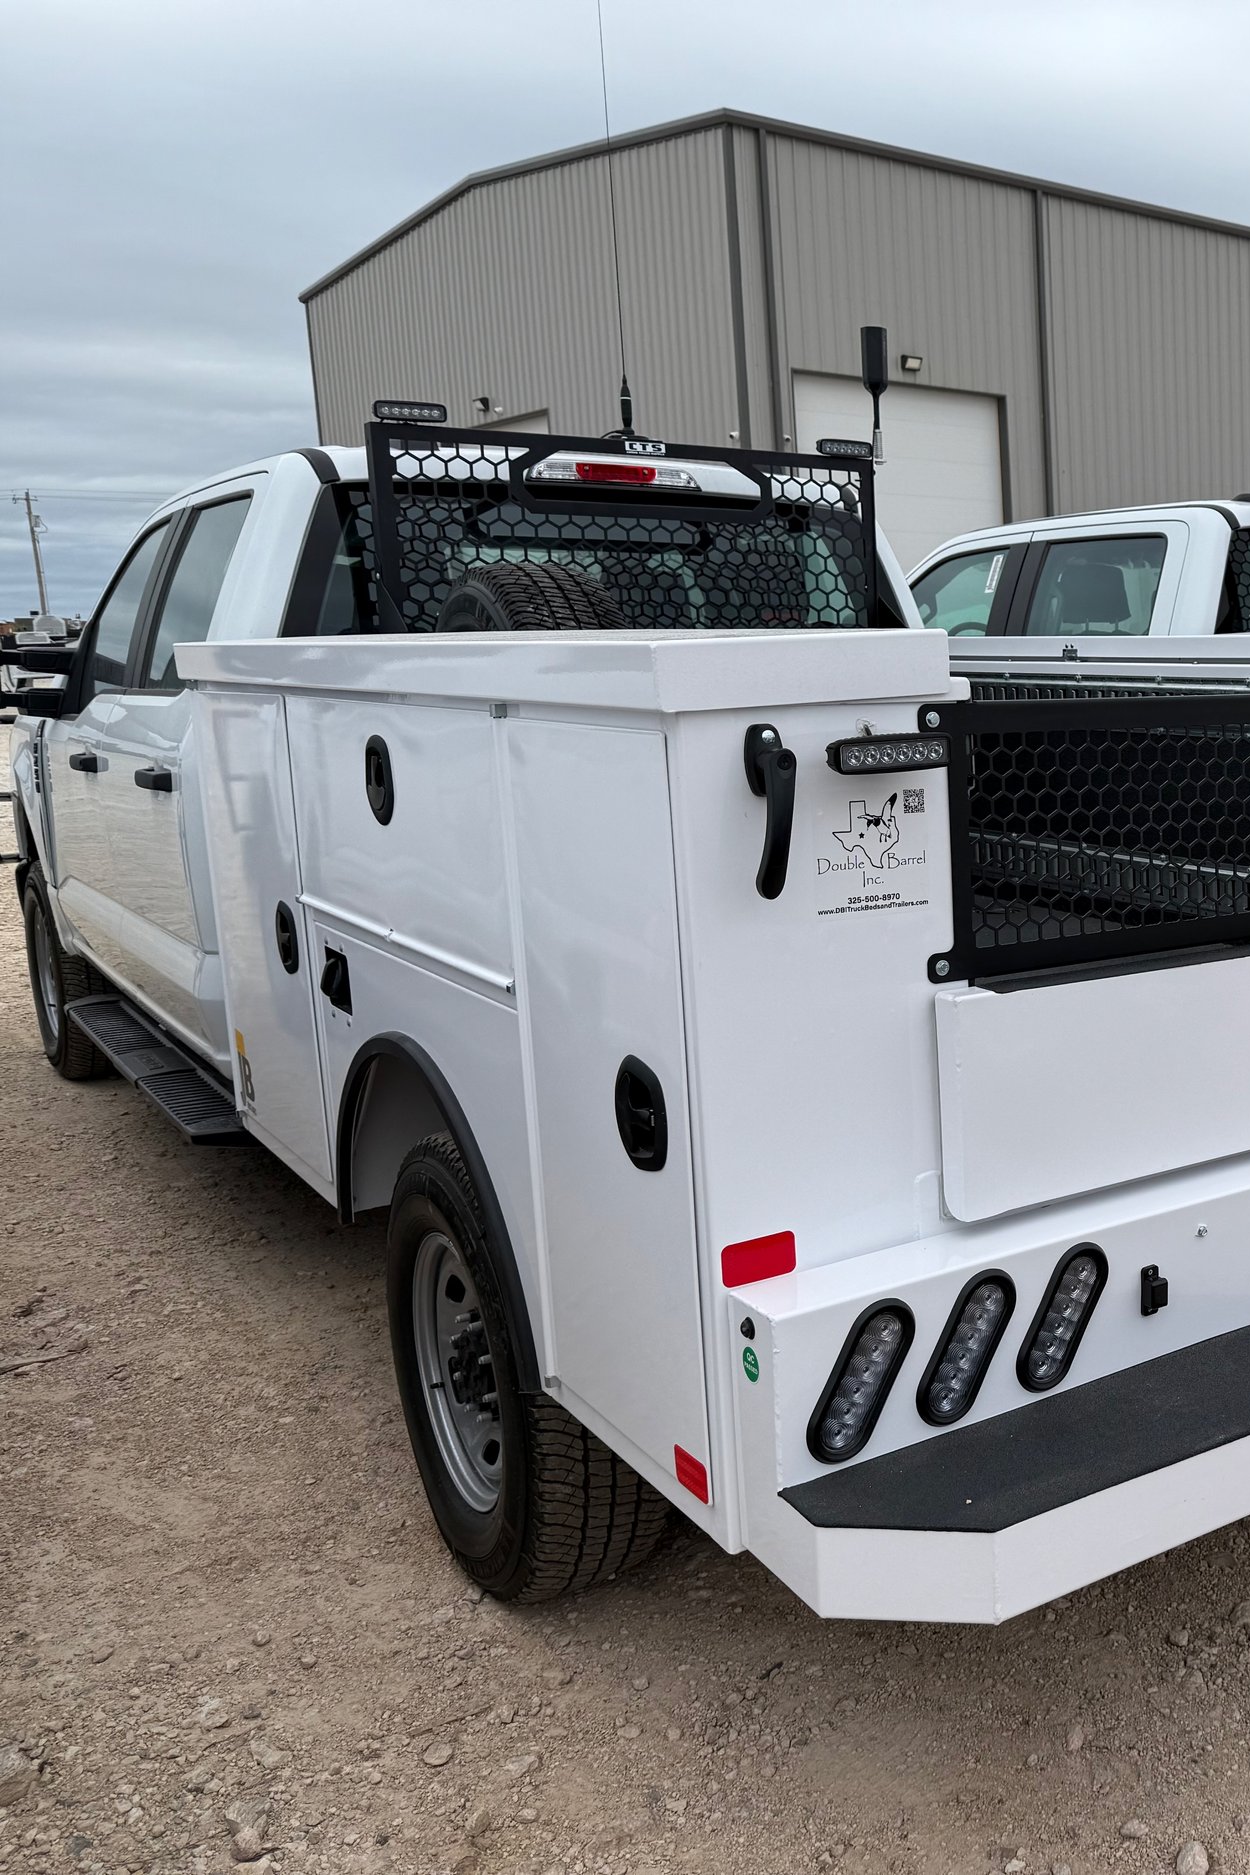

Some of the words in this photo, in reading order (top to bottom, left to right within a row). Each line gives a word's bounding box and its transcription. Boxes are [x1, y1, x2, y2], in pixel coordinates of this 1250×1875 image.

[628, 442, 663, 452] CTS
[817, 855, 865, 875] Double
[887, 850, 926, 869] Barrel
[863, 871, 884, 888] Inc.
[847, 893, 900, 905] 325-500-8970
[746, 1352, 755, 1364] QC
